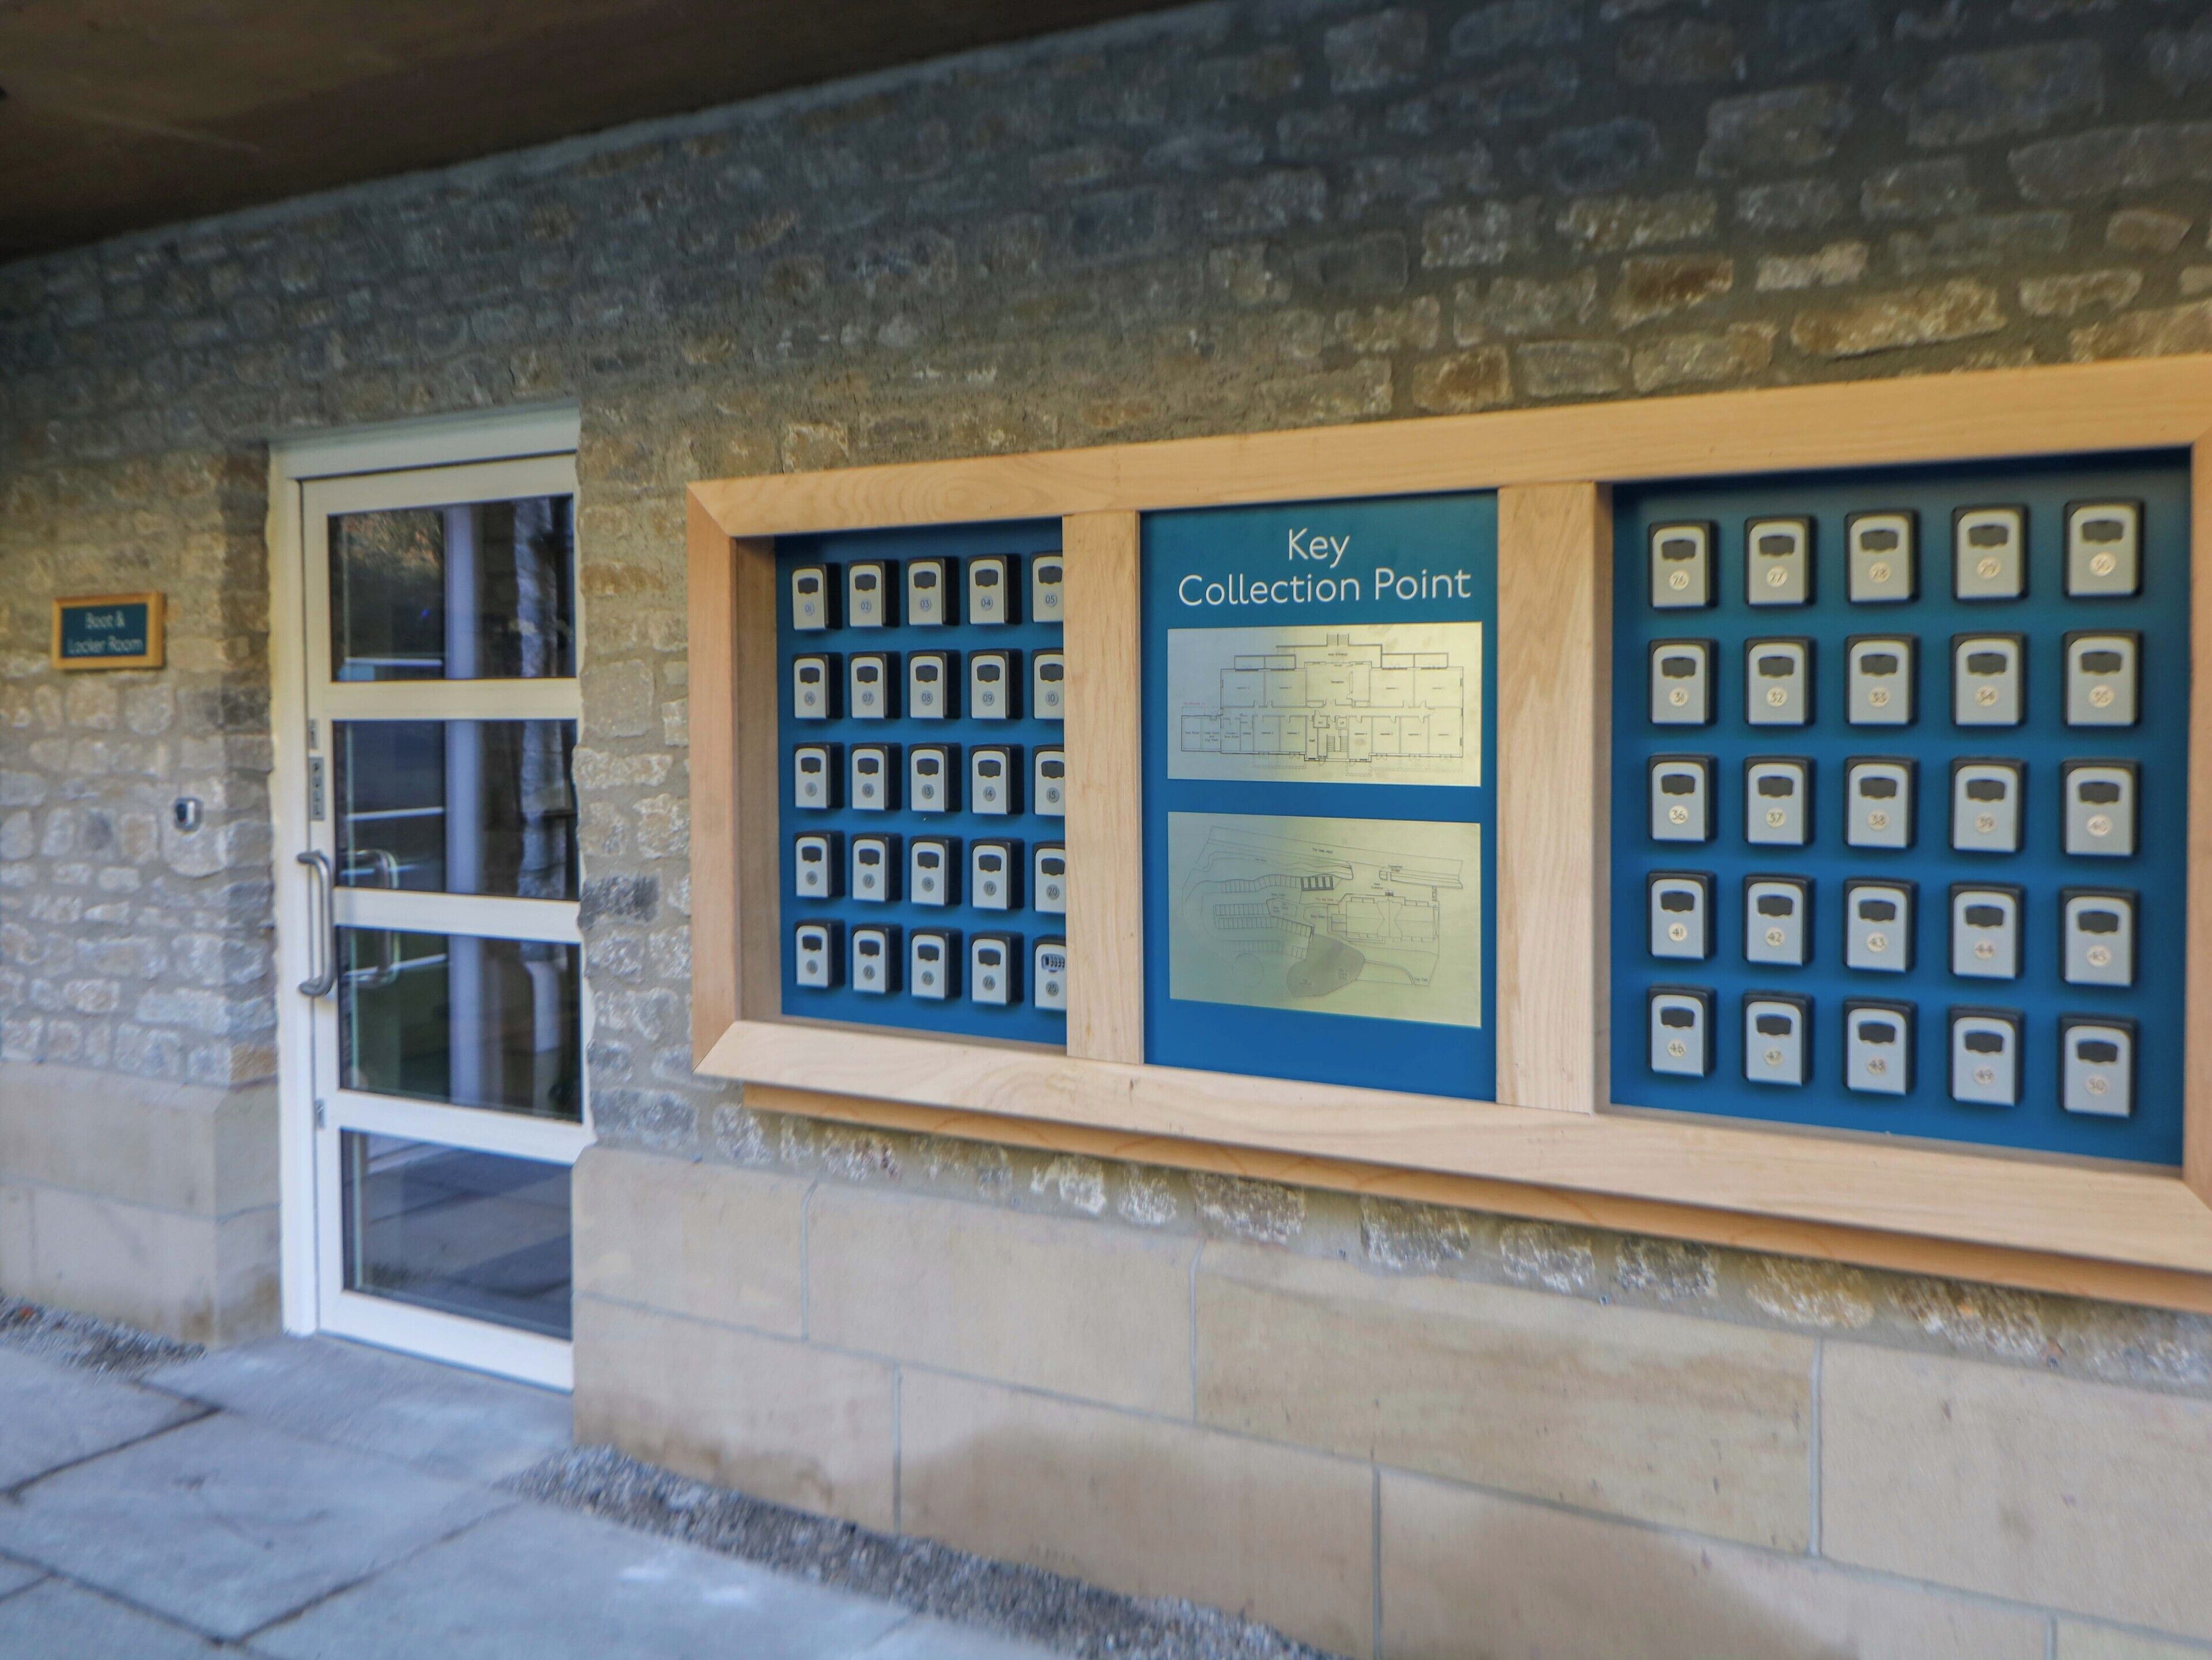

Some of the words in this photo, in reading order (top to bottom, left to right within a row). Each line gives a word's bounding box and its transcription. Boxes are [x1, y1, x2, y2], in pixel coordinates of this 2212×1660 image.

[1287, 527, 1350, 569] Key
[1770, 571, 1785, 582] 27
[1178, 573, 1360, 606] Collection
[1374, 567, 1472, 600] Point
[921, 599, 930, 608] 03
[981, 598, 991, 608] 04
[1046, 595, 1055, 604] 05
[861, 601, 869, 610] 02
[862, 693, 872, 702] 07
[922, 693, 931, 702] 08
[983, 694, 993, 702] 09
[1048, 694, 1055, 702] 10
[1771, 692, 1783, 702] 32
[1872, 692, 1887, 702] 33
[865, 786, 871, 795] 12
[925, 787, 931, 795] 13
[986, 790, 993, 798] 14
[1049, 791, 1055, 799] 15
[1671, 809, 1686, 821] 36
[1768, 812, 1782, 823] 37
[1977, 817, 1994, 828] 39
[986, 884, 994, 893] 19
[1048, 888, 1057, 896] 20
[1672, 927, 1683, 937] 41
[1767, 932, 1782, 942] 42
[1975, 944, 1994, 954] 44
[1670, 1043, 1684, 1053] 46
